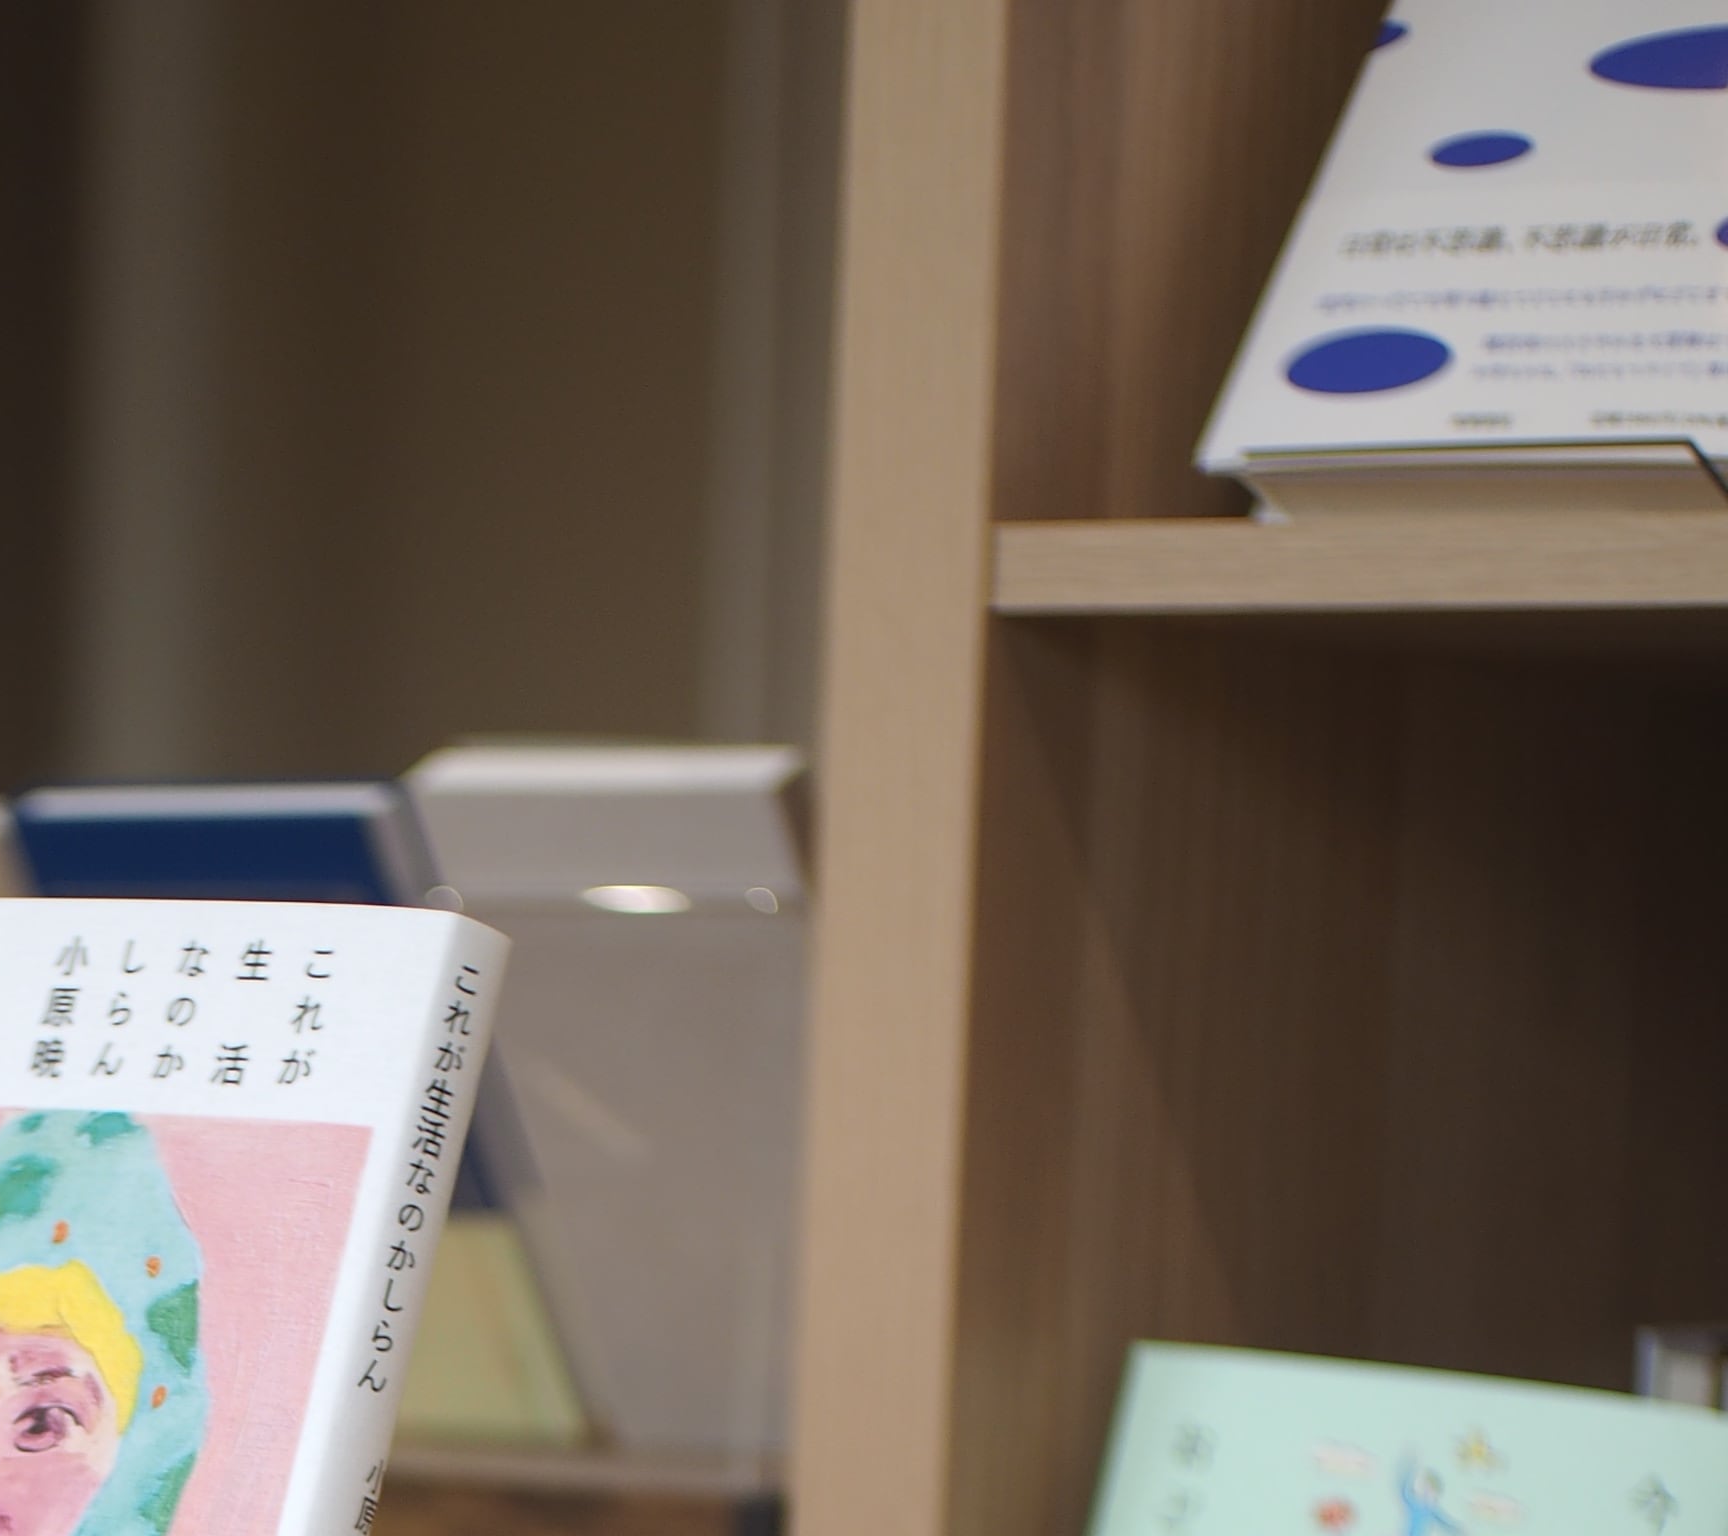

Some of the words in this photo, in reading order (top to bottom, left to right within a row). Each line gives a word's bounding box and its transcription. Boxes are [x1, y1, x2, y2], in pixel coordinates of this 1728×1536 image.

[29, 936, 89, 1079] 小原晩
[90, 940, 146, 1078] しらん
[150, 943, 210, 1080] なのか
[211, 939, 271, 1087] 生活
[277, 947, 336, 1086] これが
[357, 962, 482, 1394] これが生活なのかしらん
